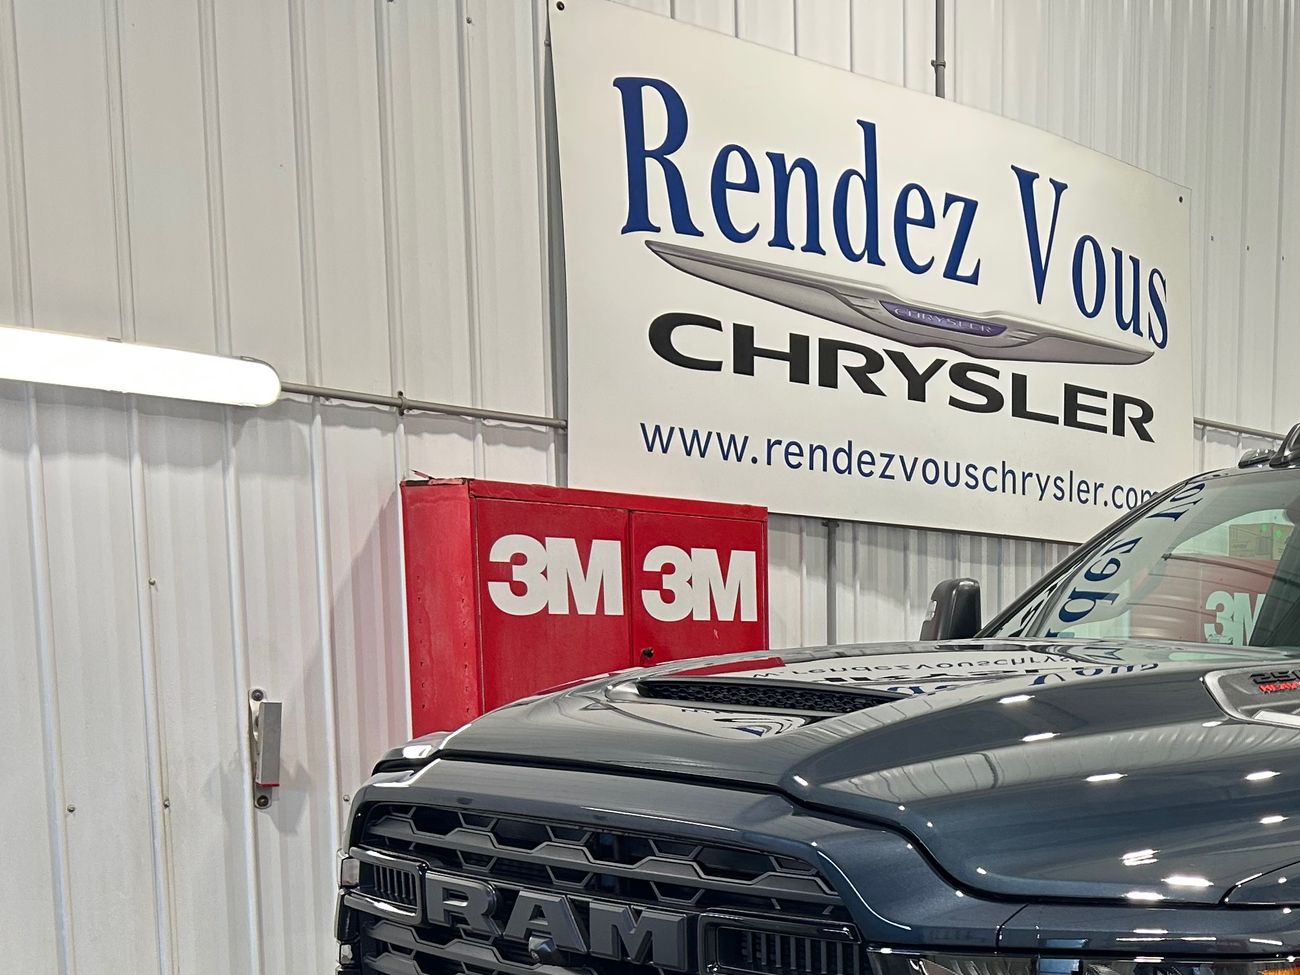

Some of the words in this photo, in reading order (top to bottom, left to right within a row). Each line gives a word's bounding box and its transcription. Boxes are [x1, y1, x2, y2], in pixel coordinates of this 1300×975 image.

[612, 76, 981, 286] Rendez
[1011, 164, 1169, 350] Vous
[894, 307, 993, 334] CHRYSLER
[648, 312, 1156, 443] CHRYSLER
[488, 534, 625, 616] 3M
[641, 545, 758, 622] 3M
[425, 870, 689, 972] RAM
